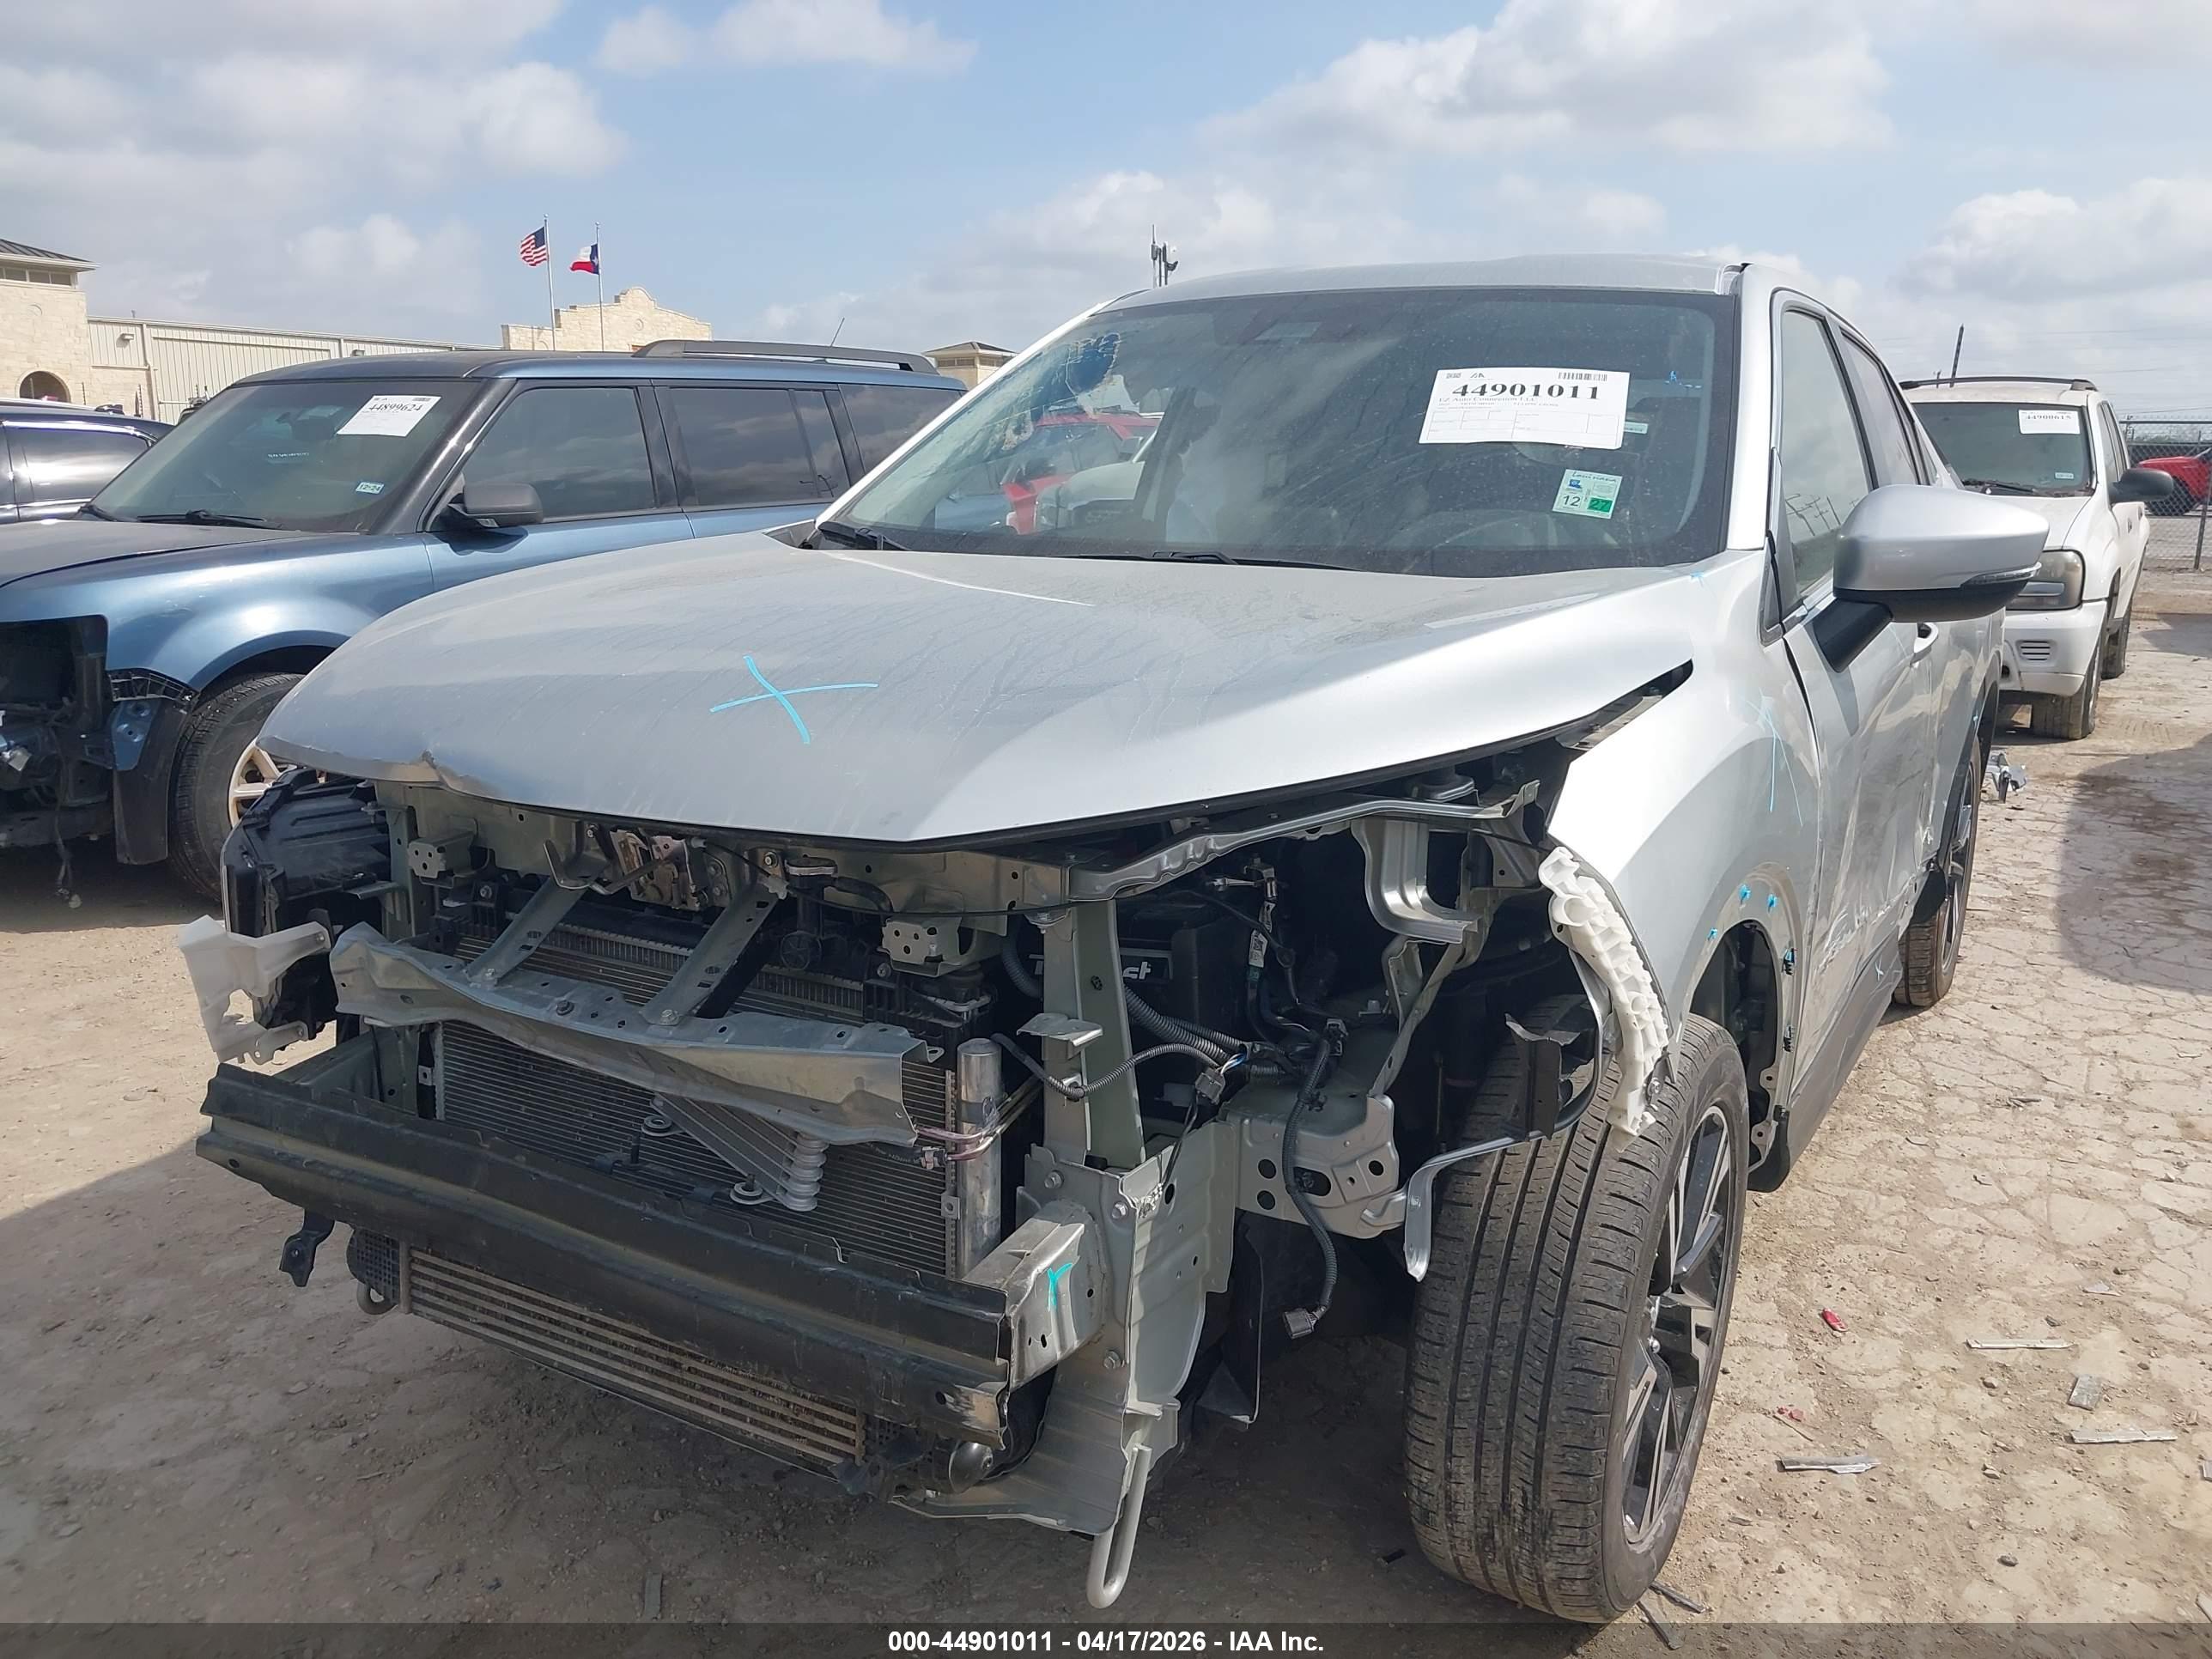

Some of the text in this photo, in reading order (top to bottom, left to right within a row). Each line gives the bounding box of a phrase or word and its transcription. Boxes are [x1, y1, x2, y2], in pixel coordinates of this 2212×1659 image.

[1452, 383, 1600, 400] 44901011
[368, 403, 424, 411] 44899624
[1563, 495, 1581, 507] 12
[1590, 498, 1609, 510] 27
